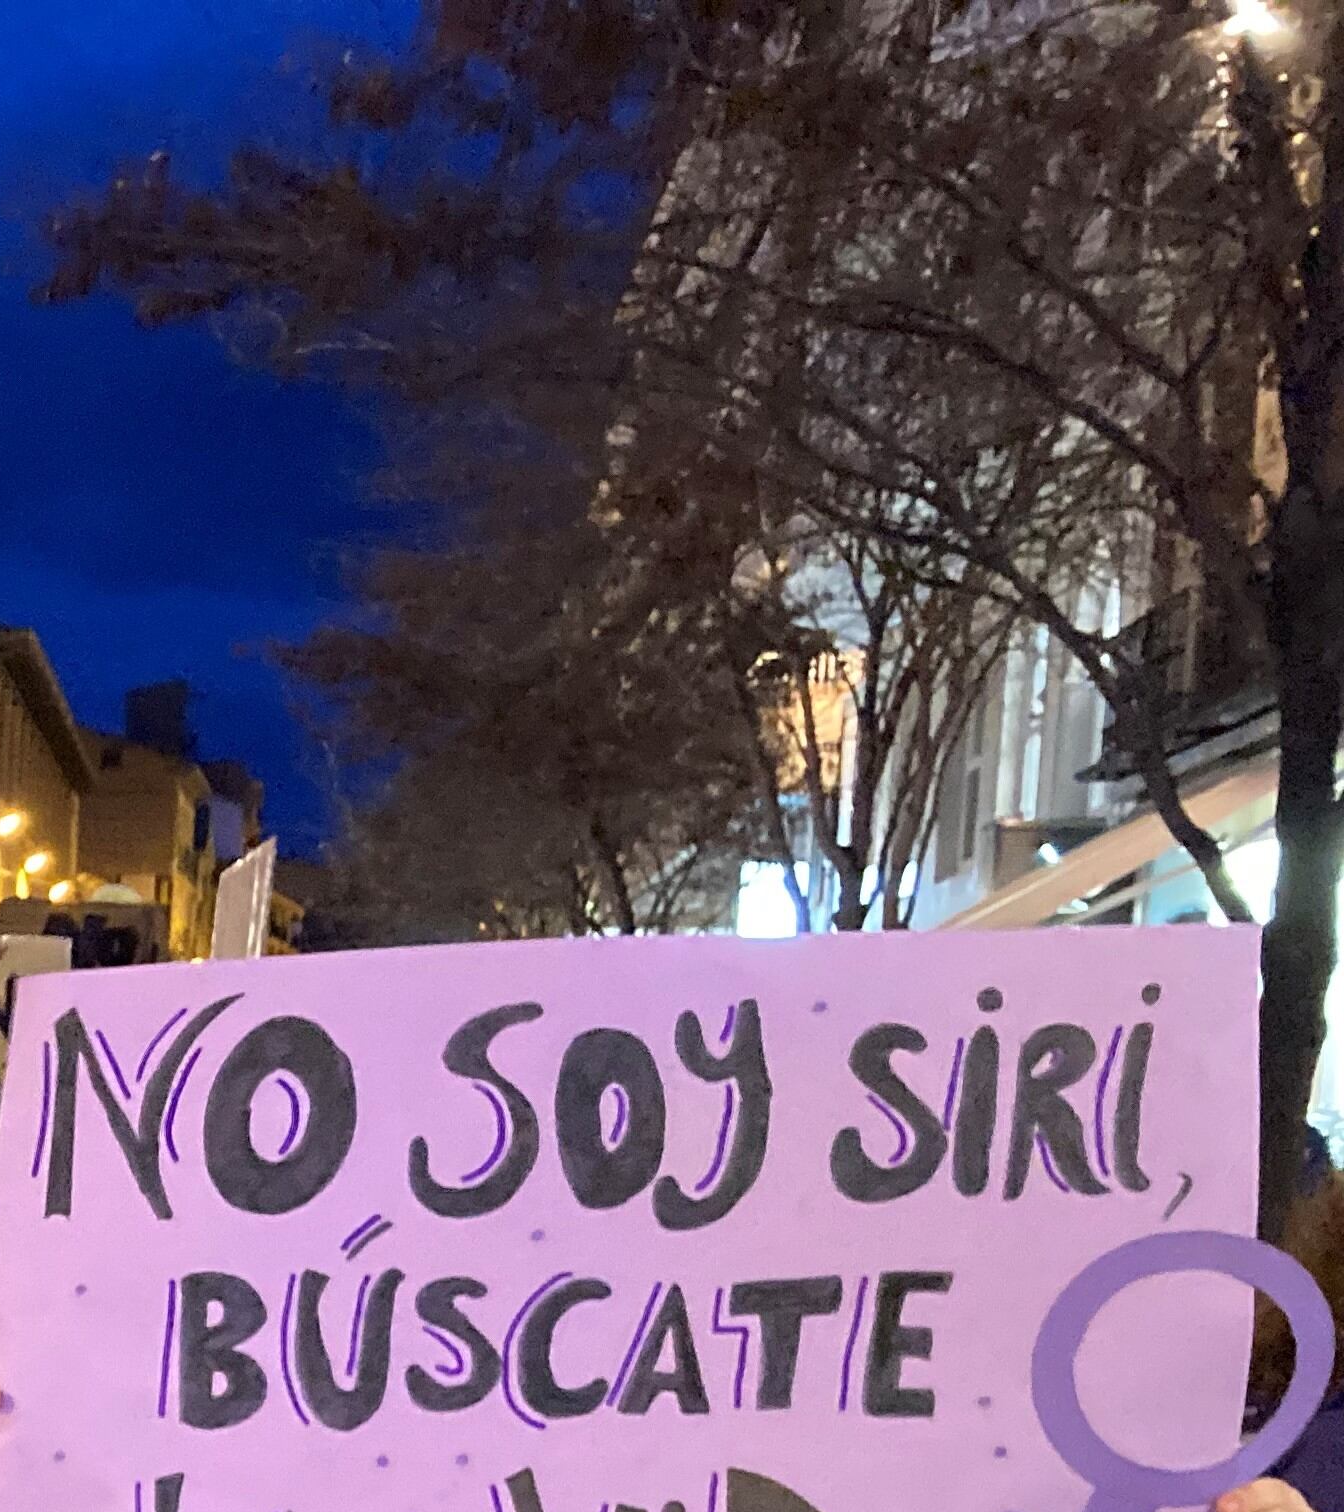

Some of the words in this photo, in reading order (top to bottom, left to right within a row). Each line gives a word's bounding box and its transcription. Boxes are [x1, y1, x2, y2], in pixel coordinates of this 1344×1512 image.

[32, 991, 358, 1220] NO
[408, 996, 772, 1231] SOY
[160, 1214, 954, 1433] BÚSCATE
